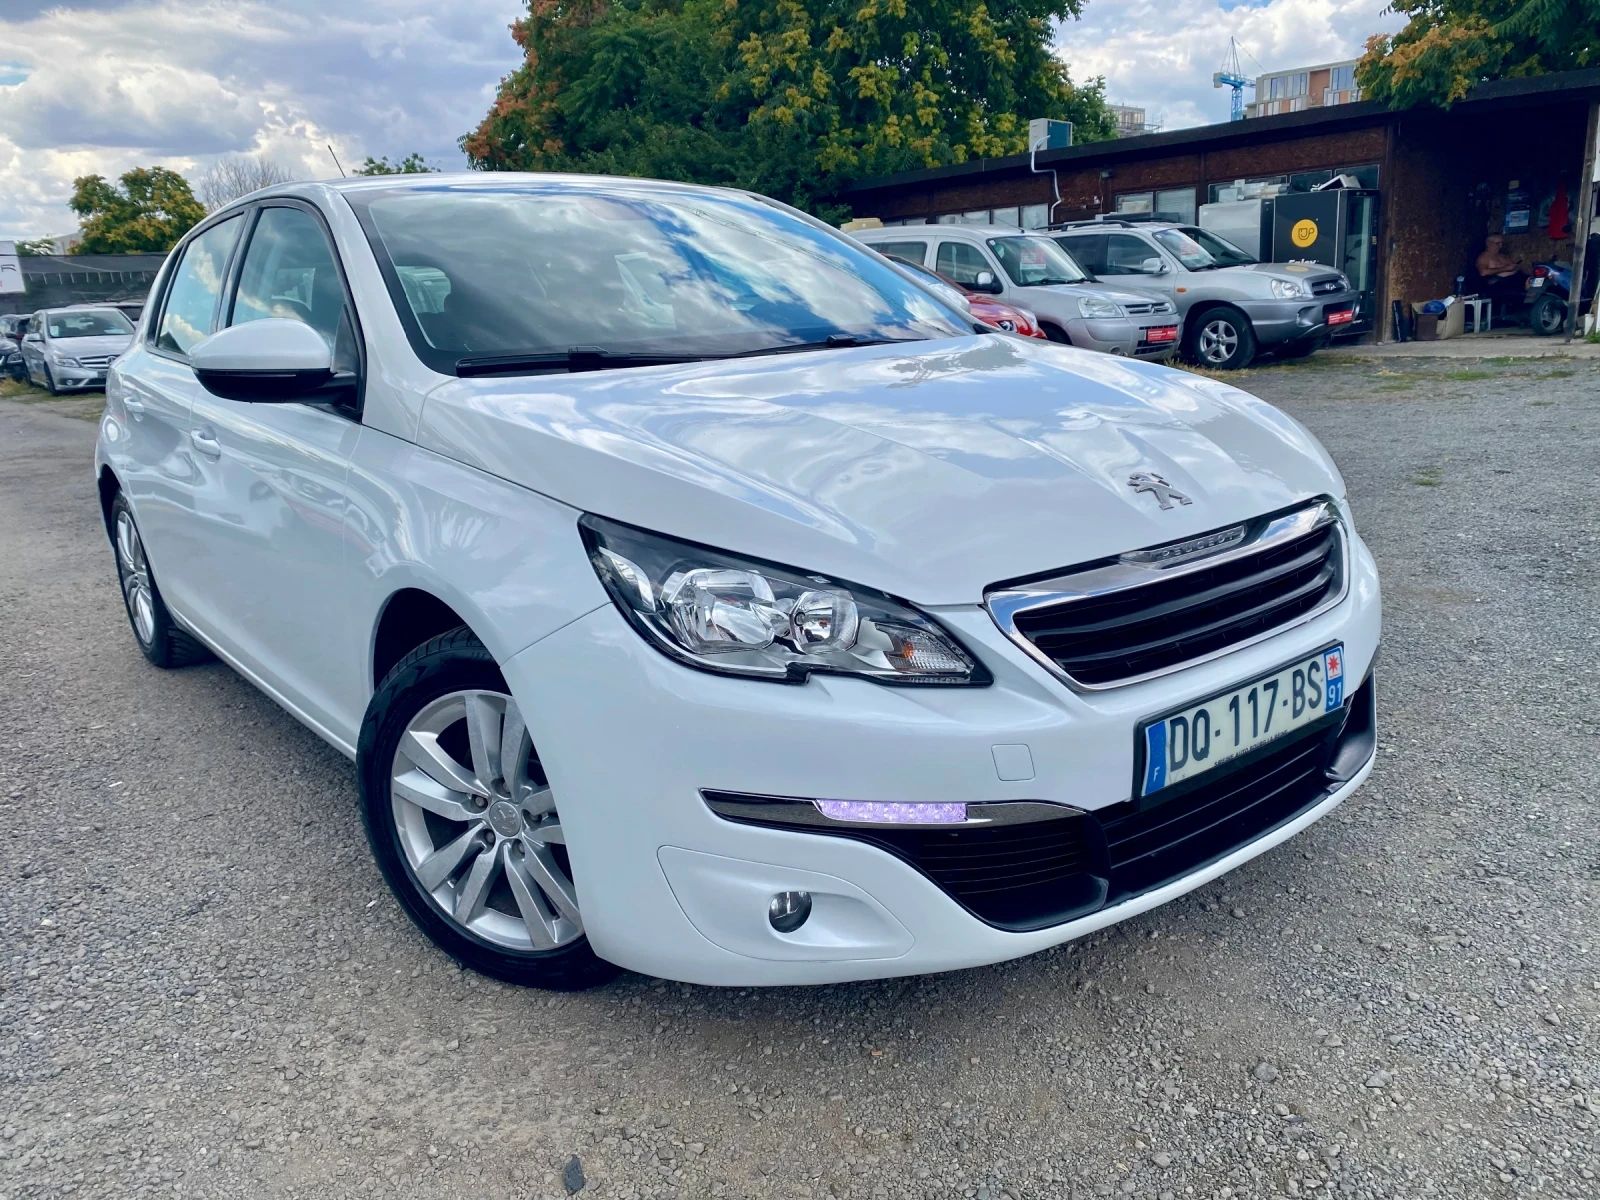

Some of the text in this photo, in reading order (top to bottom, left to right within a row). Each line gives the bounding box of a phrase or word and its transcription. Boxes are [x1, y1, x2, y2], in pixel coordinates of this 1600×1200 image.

[1328, 682, 1343, 706] 91
[1169, 660, 1323, 772] DQ-117-BS
[1153, 766, 1161, 782] F
